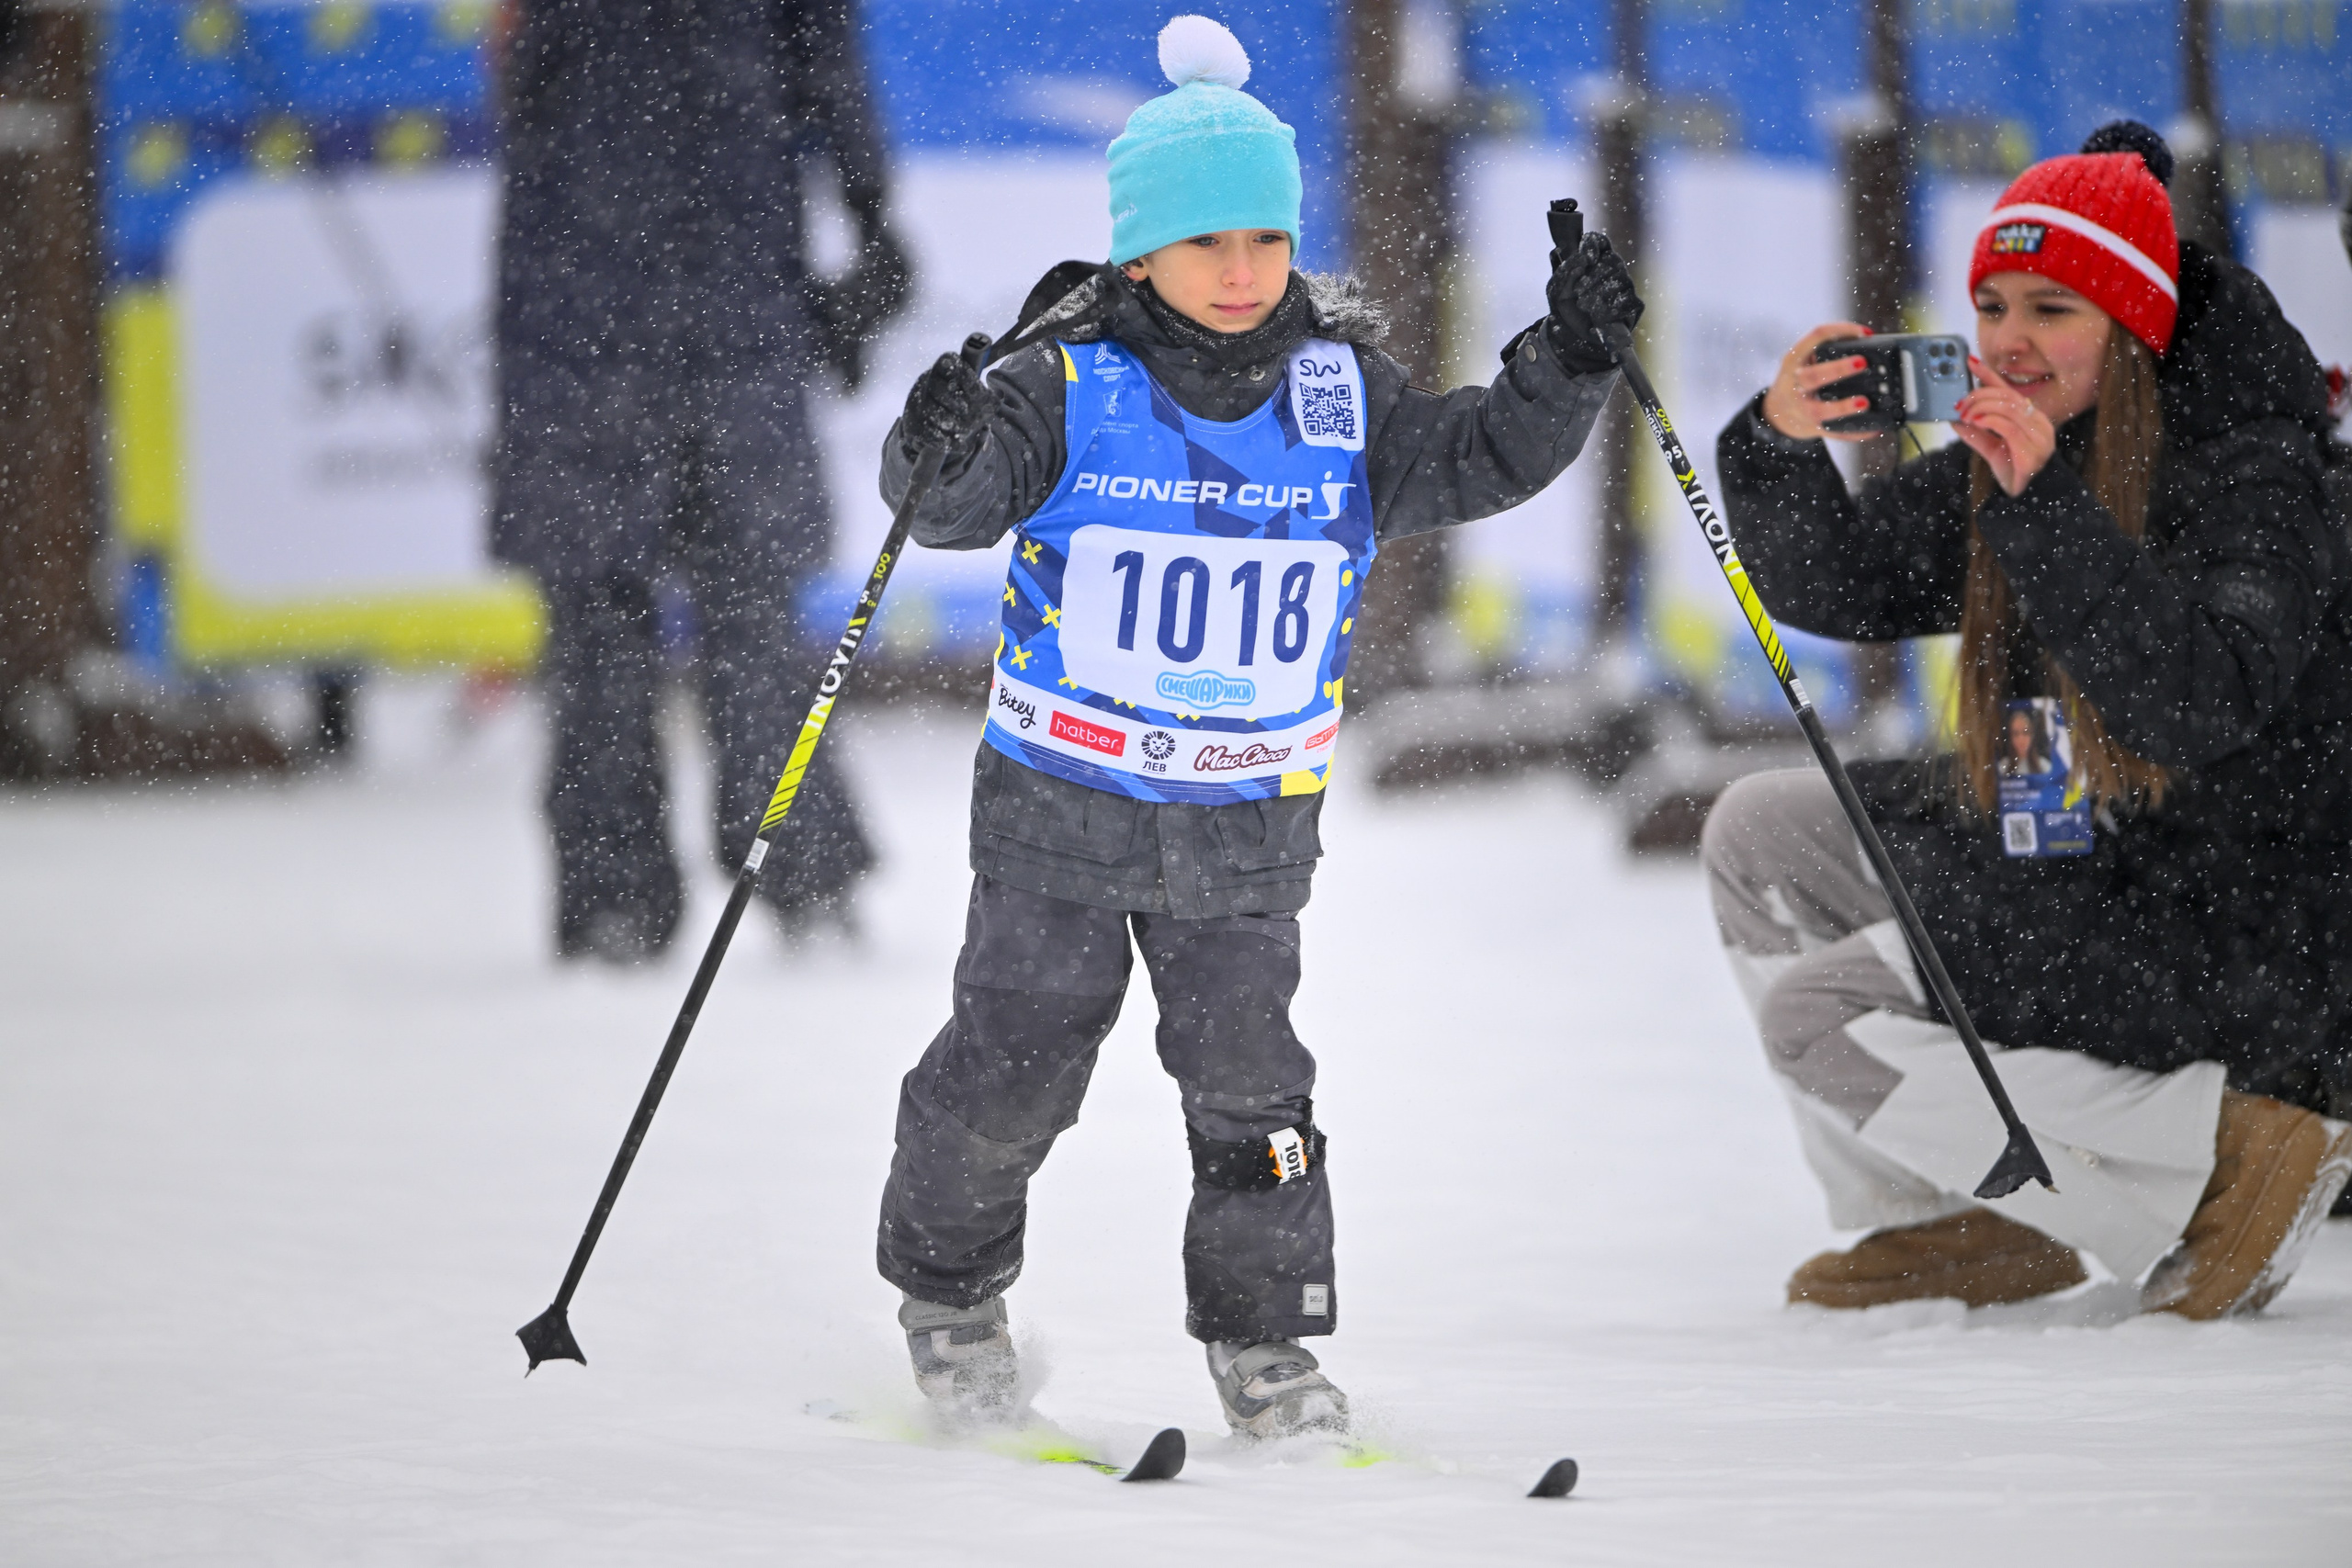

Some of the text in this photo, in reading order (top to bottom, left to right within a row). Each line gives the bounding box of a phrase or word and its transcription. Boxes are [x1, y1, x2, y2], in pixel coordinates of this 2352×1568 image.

[1072, 472, 1313, 509] PIONER CUP
[874, 552, 891, 579] 100
[1113, 549, 1316, 666] 1018
[998, 687, 1036, 729] Bitey
[1056, 717, 1119, 750] hatber
[1142, 761, 1167, 773] ЛЕВ
[1194, 743, 1293, 771] MacChoco
[915, 1312, 937, 1321] CLASSIC
